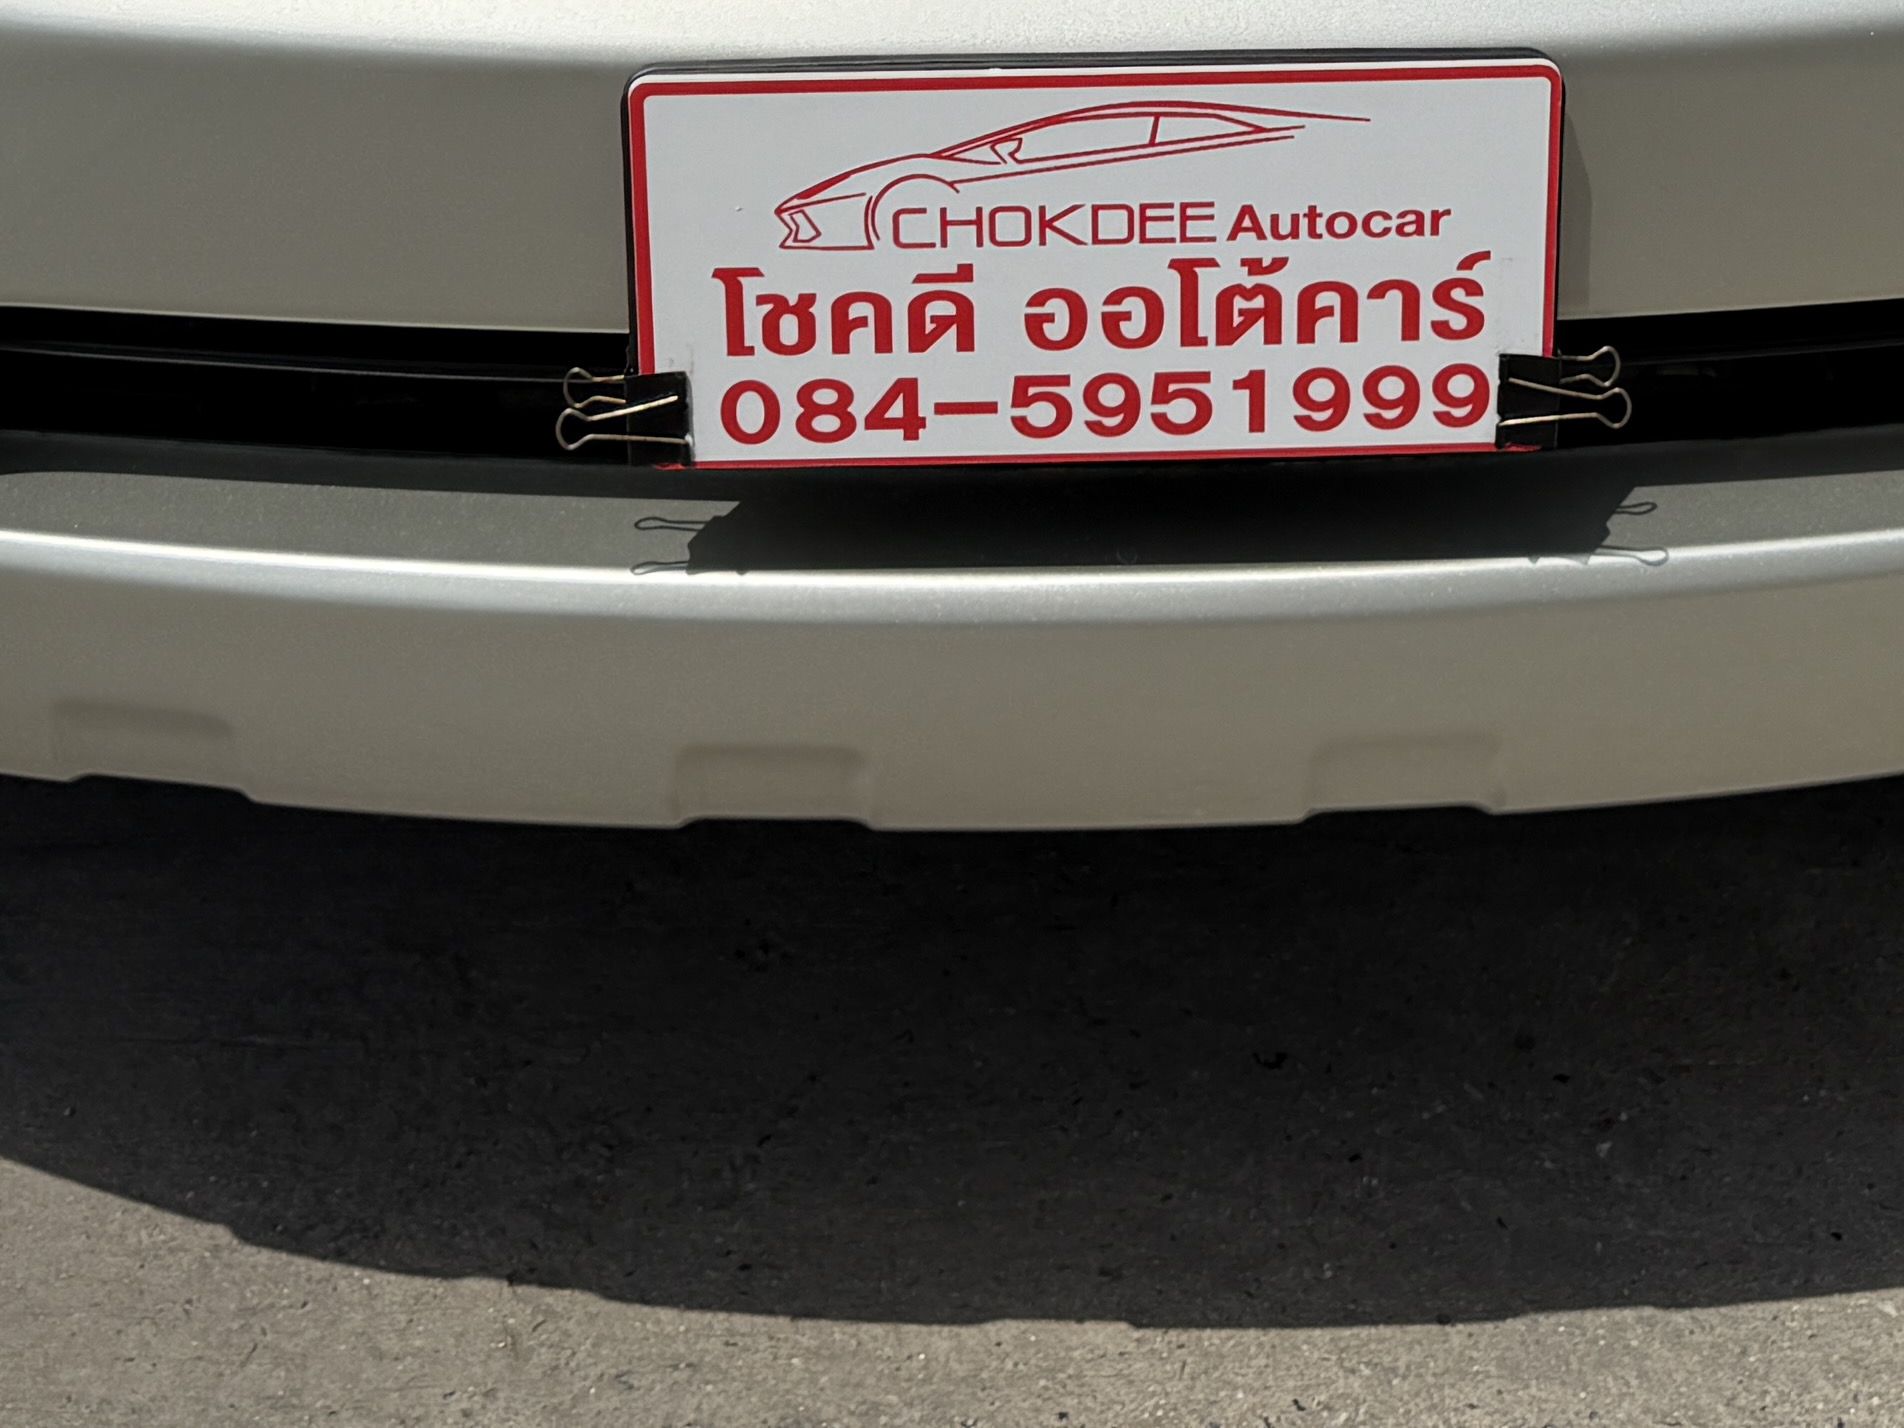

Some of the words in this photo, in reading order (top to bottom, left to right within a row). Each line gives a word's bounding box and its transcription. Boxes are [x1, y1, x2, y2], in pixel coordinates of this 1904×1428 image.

[892, 201, 1216, 249] CHOKDEE
[1227, 204, 1452, 243] Autocar
[711, 262, 977, 358] โชคดี
[1023, 250, 1492, 352] ออโต้คาร์
[719, 363, 1492, 446] 084-5951999
